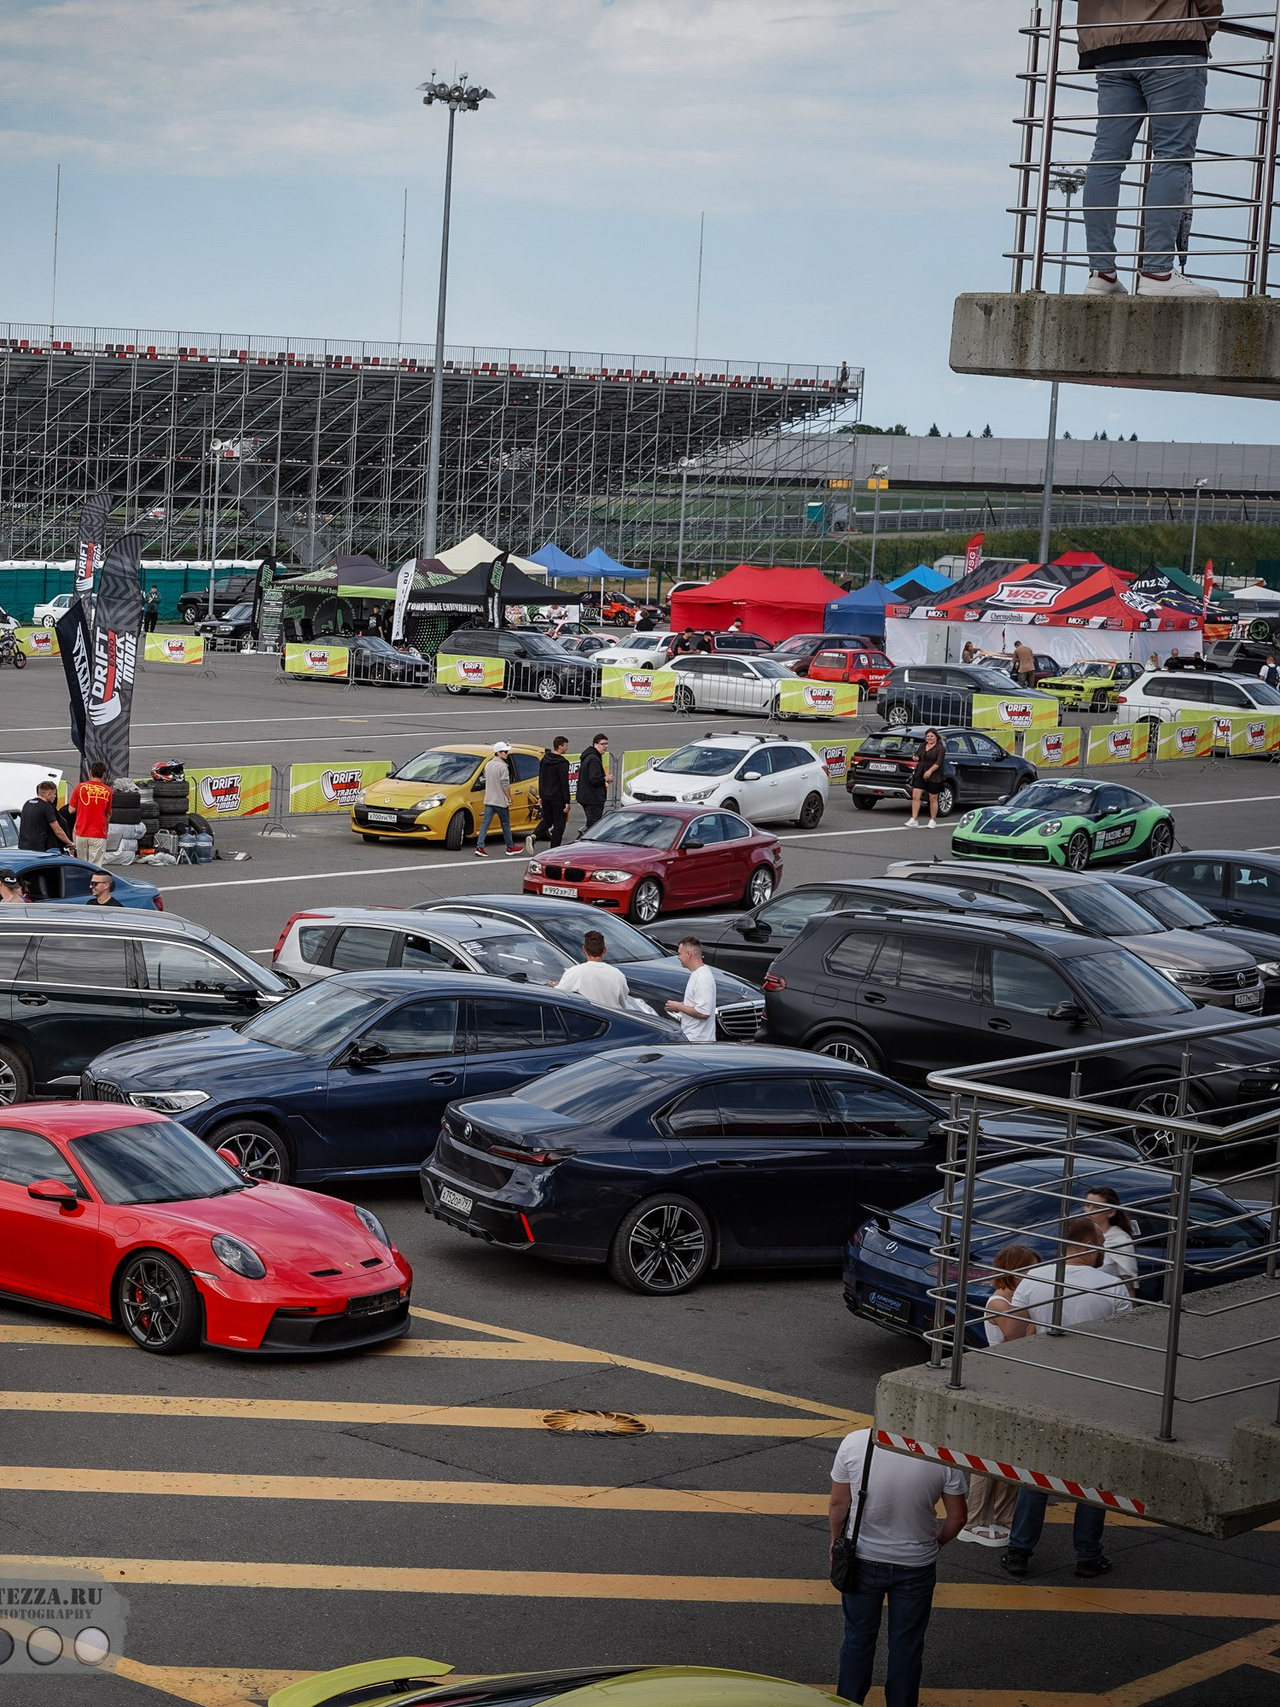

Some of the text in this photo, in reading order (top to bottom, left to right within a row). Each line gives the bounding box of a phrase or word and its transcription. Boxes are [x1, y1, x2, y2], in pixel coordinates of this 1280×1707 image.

[78, 541, 88, 578] DRIFT
[1006, 589, 1049, 600] WSG
[407, 602, 442, 611] ГОНОЧНЫЕ
[92, 626, 108, 699] DRIFT
[115, 634, 125, 690] TRACK
[123, 631, 137, 684] MODE
[1008, 704, 1031, 712] DRIFT
[826, 748, 846, 758] DRIFT
[212, 776, 239, 790] DRIFT
[333, 771, 360, 784] DRIFT
[337, 789, 360, 797] TRACK
[1030, 783, 1093, 794] PORSCHE
[216, 793, 239, 802] TRACK
